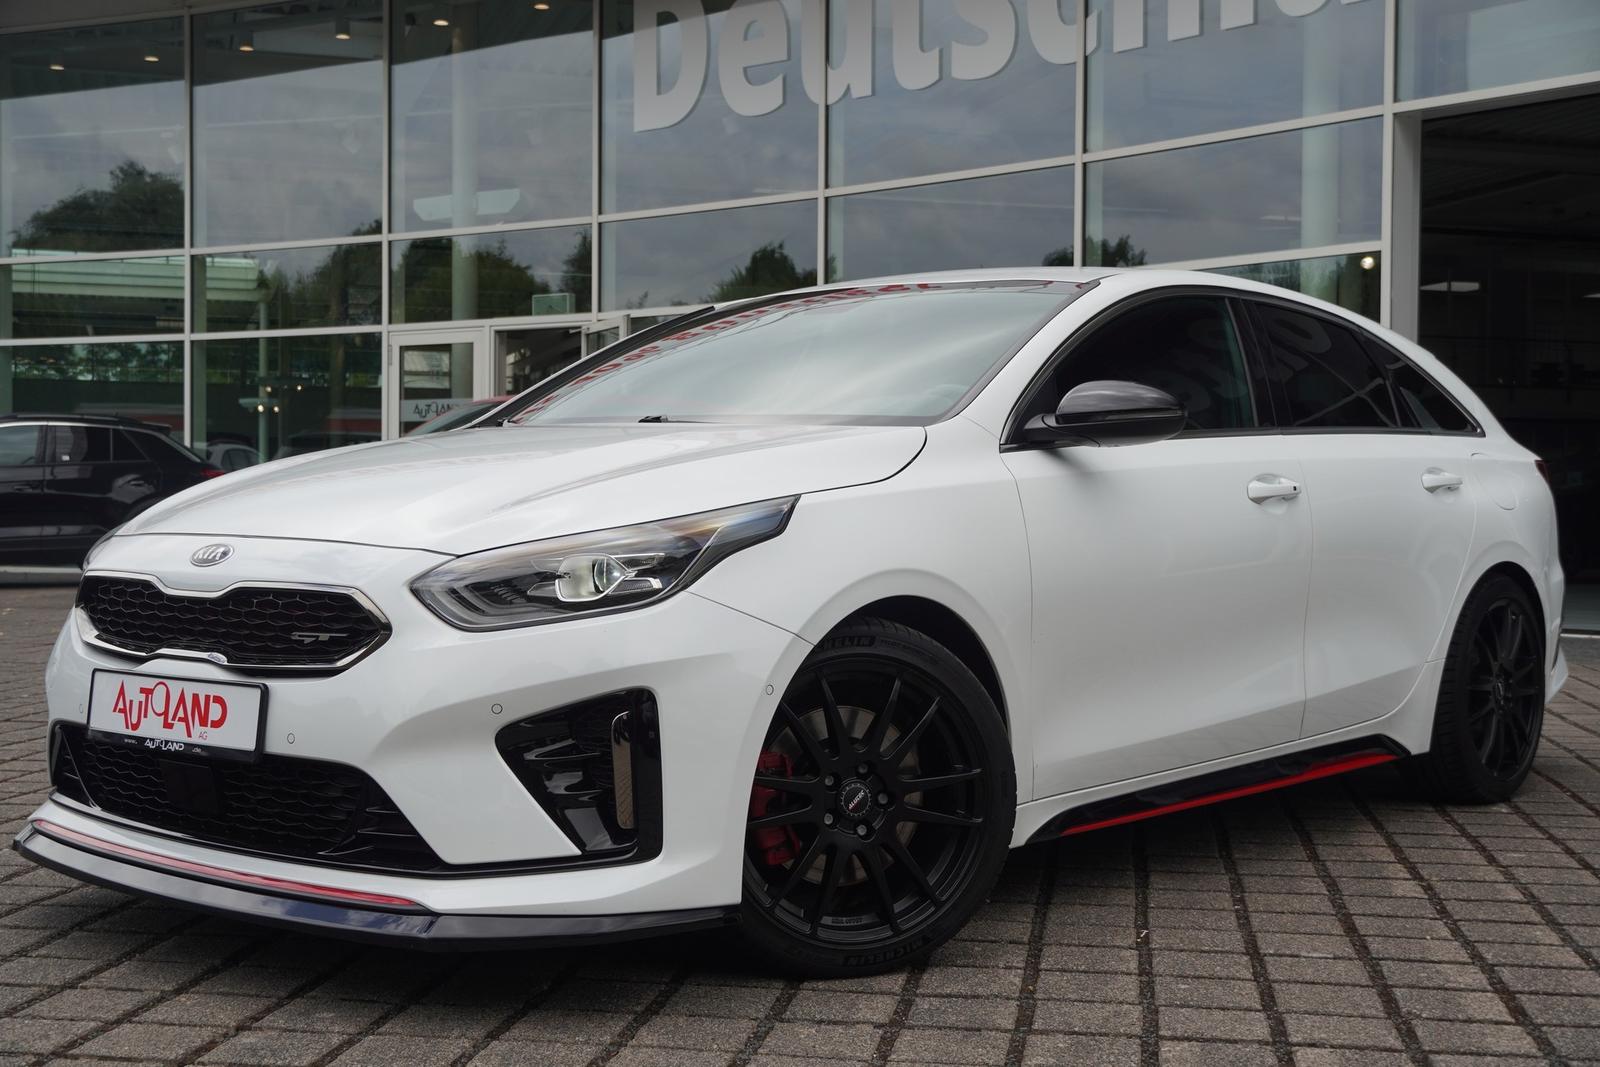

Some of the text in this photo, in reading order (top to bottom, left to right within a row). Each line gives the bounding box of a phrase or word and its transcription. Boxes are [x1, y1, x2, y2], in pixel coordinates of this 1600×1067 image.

[193, 546, 226, 561] KIA
[113, 680, 228, 738] AUTOLAND
[198, 731, 208, 741] AG
